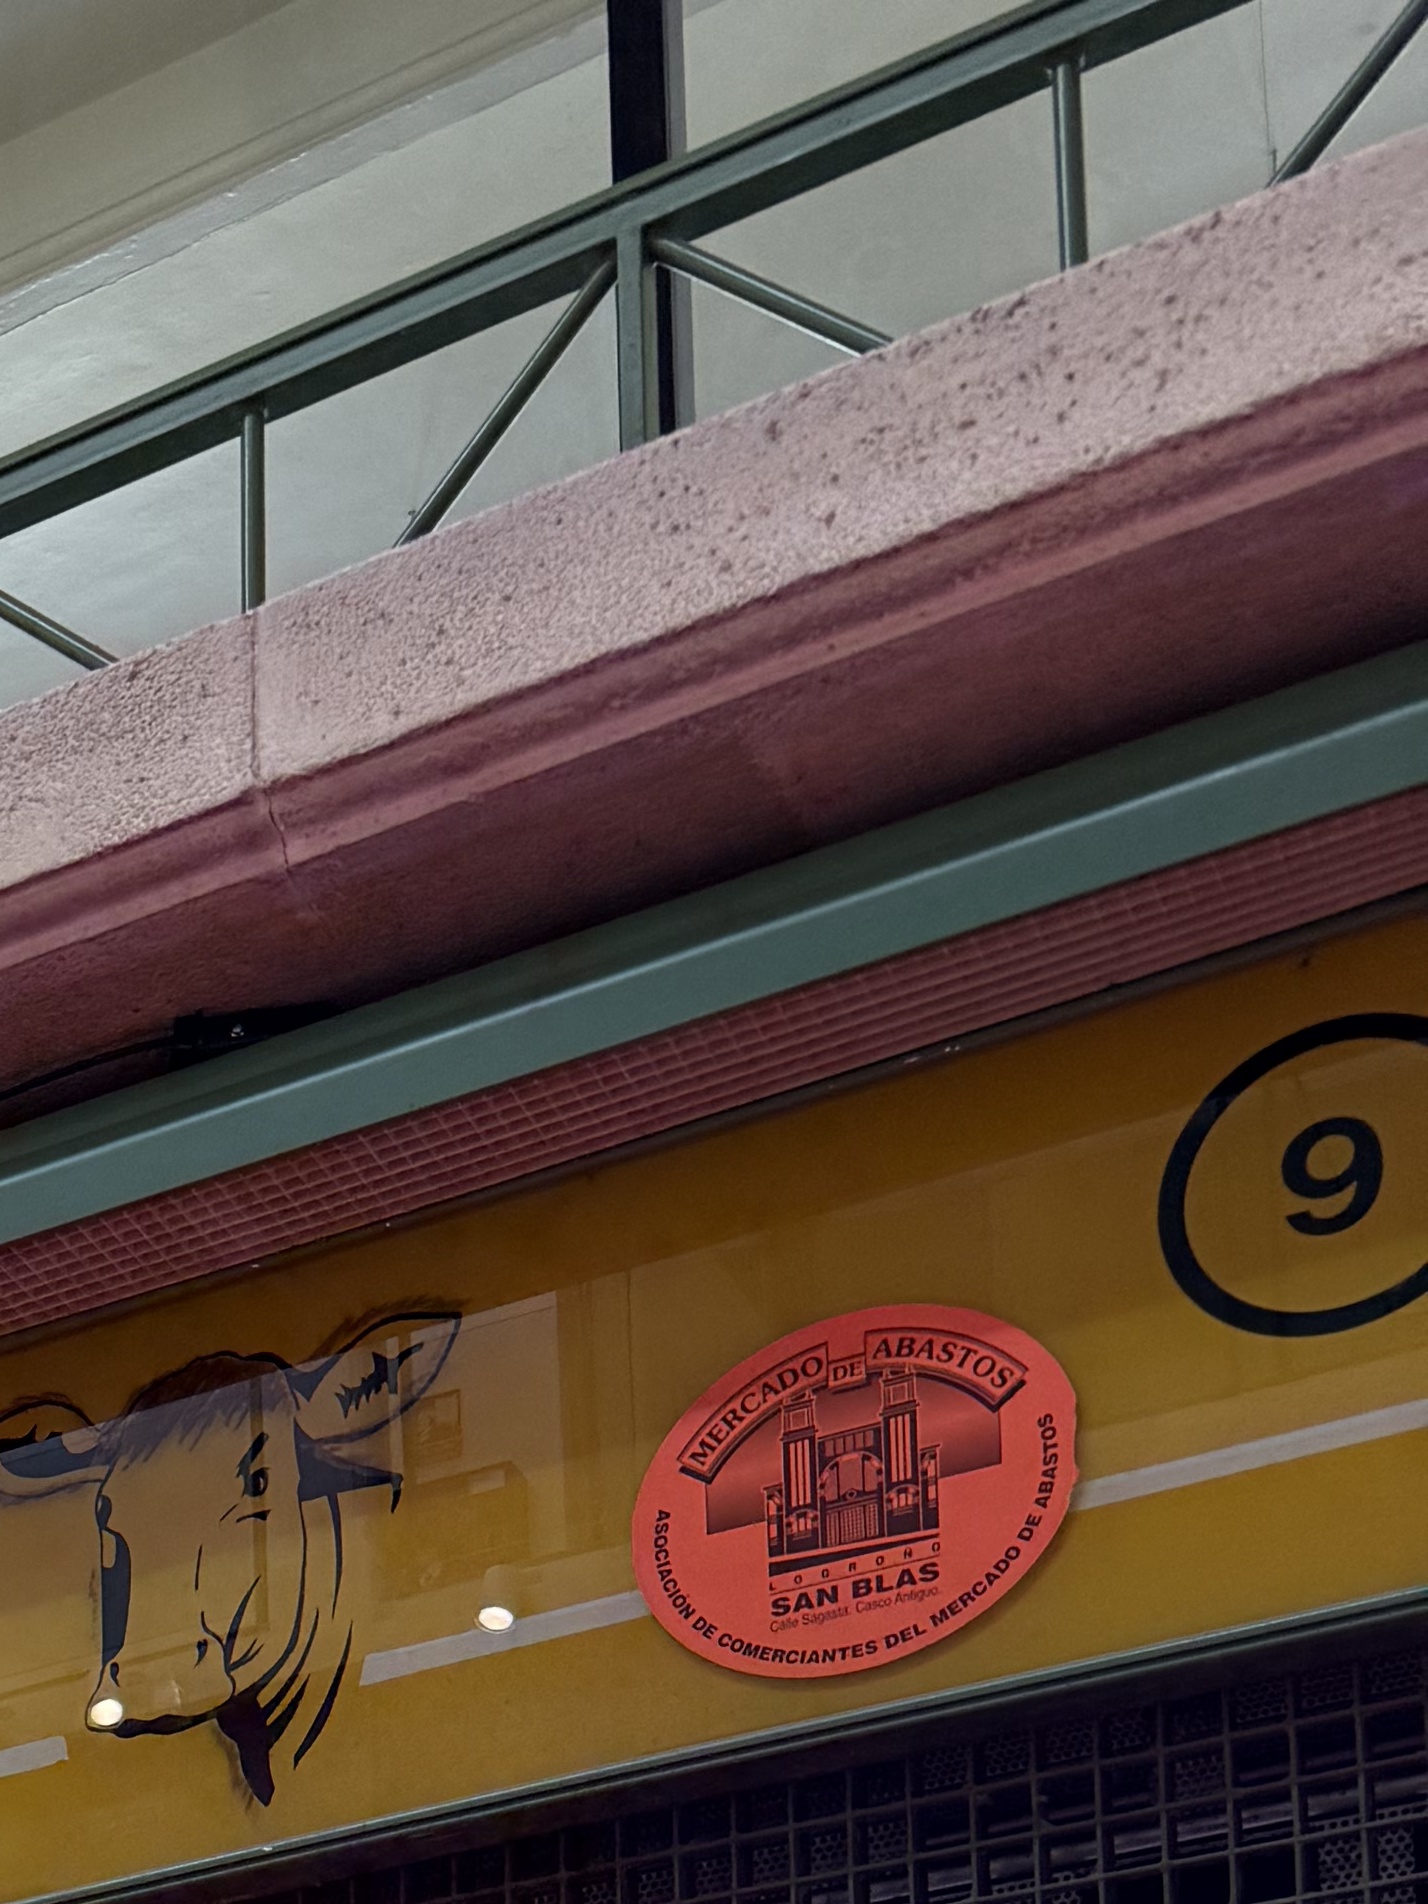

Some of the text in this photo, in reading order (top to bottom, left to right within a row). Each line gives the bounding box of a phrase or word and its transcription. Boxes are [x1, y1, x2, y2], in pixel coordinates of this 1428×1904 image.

[1280, 1117, 1384, 1236] 9
[690, 1337, 1016, 1467] MERCADO DE ABASTOS
[655, 1412, 1058, 1664] ASOCIACIÓN DE COMERCIANTES DEL MERCADO DE ABASTOS
[769, 1562, 939, 1617] SAN BLAS
